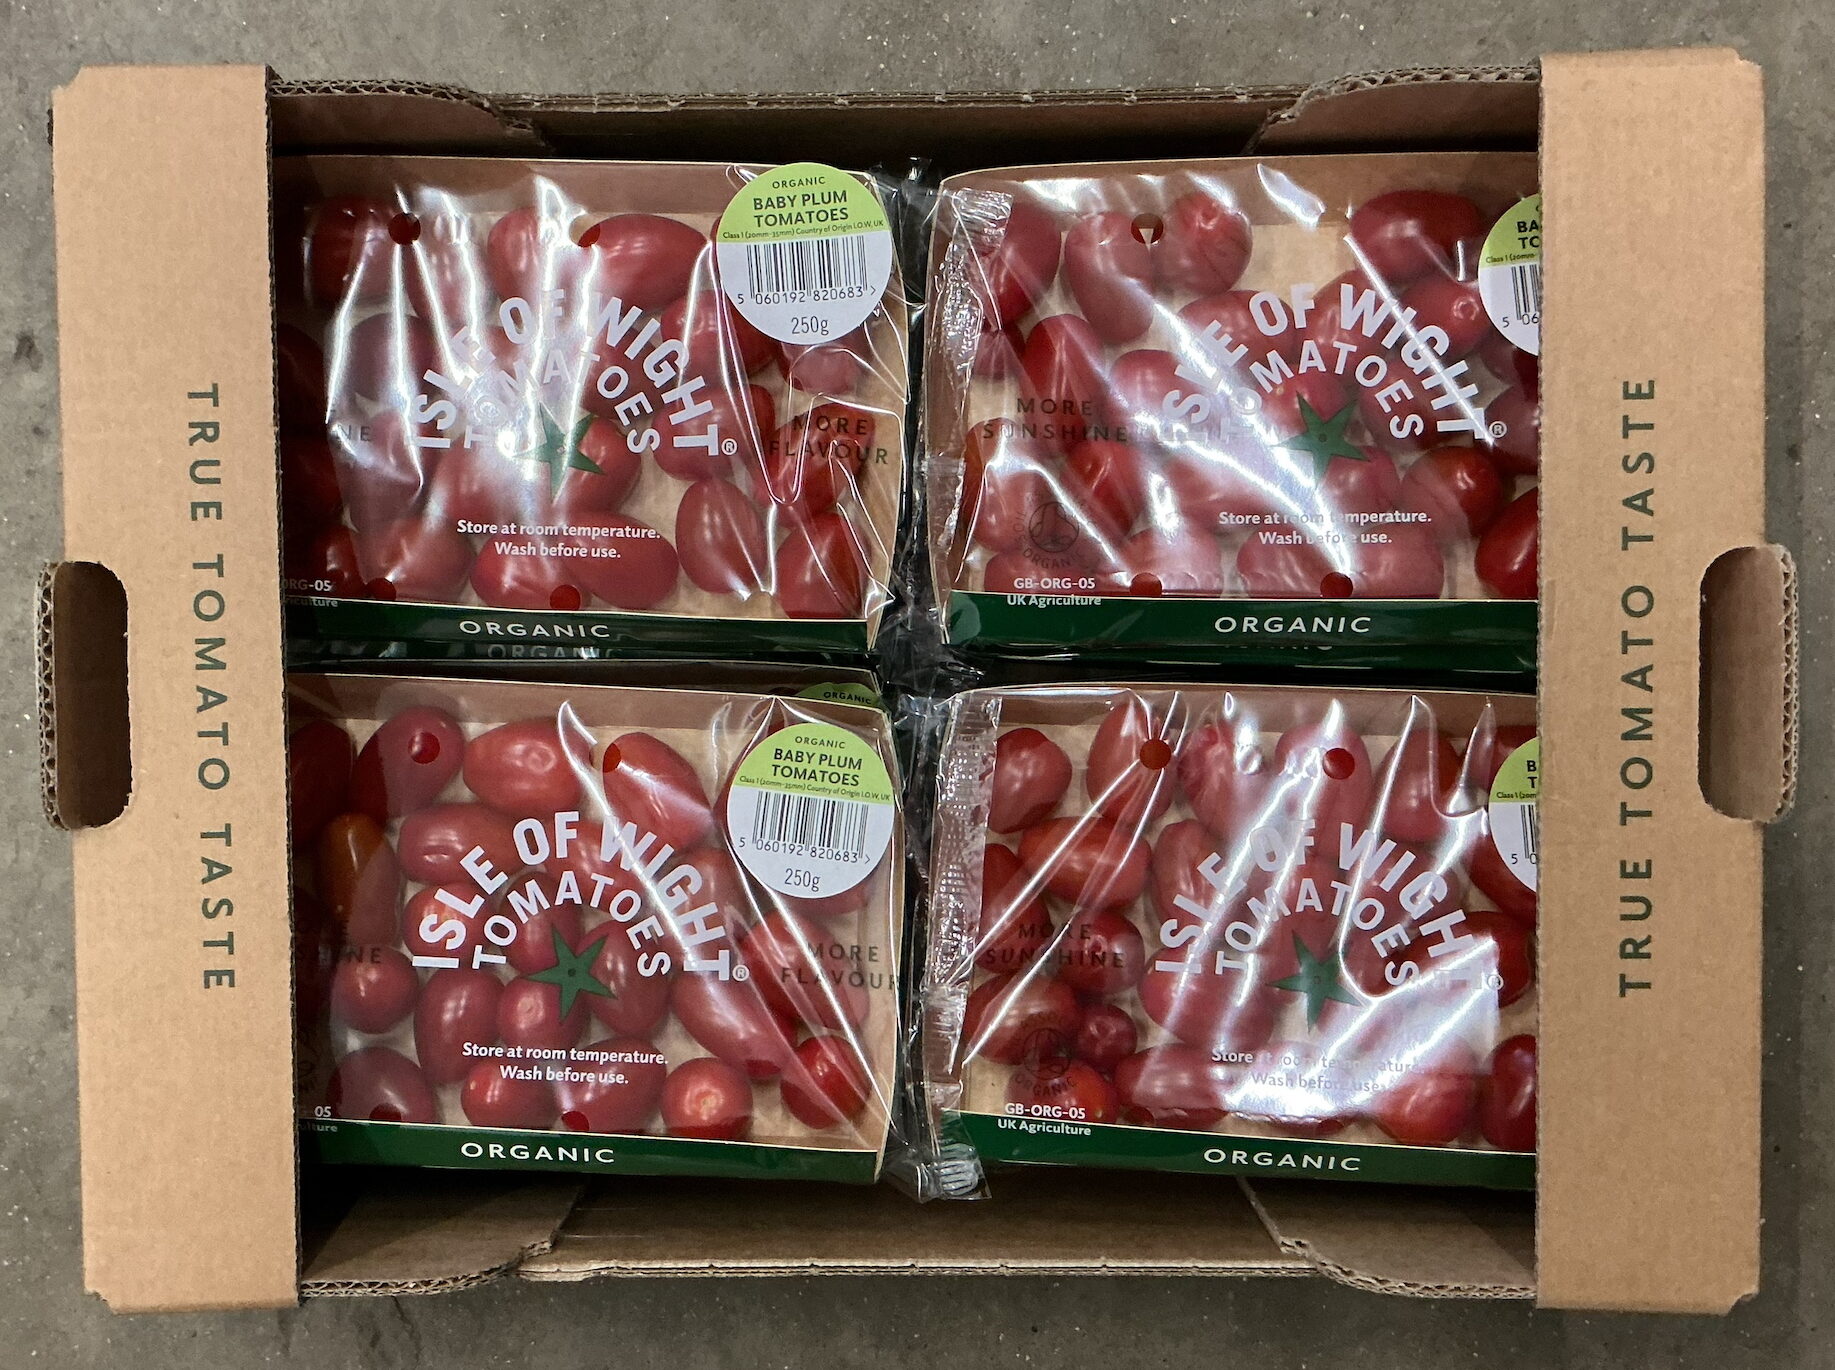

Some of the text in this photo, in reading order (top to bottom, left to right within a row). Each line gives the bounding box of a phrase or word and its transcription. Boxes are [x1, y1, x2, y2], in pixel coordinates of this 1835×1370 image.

[772, 177, 826, 189] ORGANIC
[753, 190, 848, 211] BABY PLUM
[754, 207, 849, 228] TOMATOES
[722, 231, 740, 239] Class
[796, 226, 823, 236] Country
[832, 224, 853, 233] Origin
[873, 219, 884, 227] UK
[737, 286, 864, 305] 5 060192 820683
[499, 288, 565, 346] OF
[1249, 282, 1315, 337] OF
[791, 316, 829, 335] 250g
[1016, 398, 1092, 415] MORE
[793, 416, 868, 435] MORE
[982, 422, 1128, 441] SUNSHINE
[770, 440, 888, 464] FLAVOUR
[1219, 511, 1261, 525] Store
[1264, 512, 1280, 525] at
[457, 520, 661, 540] Store at room temperature.
[1258, 530, 1302, 545] Wash
[1361, 532, 1393, 545] use.
[494, 542, 621, 559] Wash before use.
[1013, 577, 1096, 590] GB-ORG-05
[1006, 594, 1102, 608] UK Agriculture
[459, 620, 611, 638] ORGANIC
[1214, 617, 1371, 633] ORGANIC
[187, 382, 236, 990] TRUE TOMATO TASTE
[1619, 378, 1656, 998] TRUE TOMATO TASTE
[823, 691, 872, 705] ORGANIC
[794, 736, 846, 749] ORGANIC
[773, 748, 863, 771] BABY PLUM
[771, 764, 860, 787] TOMATOES
[739, 775, 755, 784] Class
[807, 784, 833, 795] Country
[833, 787, 840, 795] of
[840, 789, 861, 799] Origin
[880, 793, 891, 802] UK
[738, 836, 859, 863] 5 060192 820683
[411, 845, 508, 969] ISLE
[512, 811, 580, 865] OF
[784, 868, 821, 892] 250g
[1155, 852, 1247, 974] ISLE
[1250, 819, 1316, 872] OF
[472, 870, 672, 977] TOMATOES
[1215, 878, 1420, 986] TOMATOES
[808, 942, 880, 962] MORE
[984, 947, 1124, 969] SUNHINE
[462, 1041, 669, 1065] Store at room temperature.
[1211, 1050, 1253, 1063] Store
[499, 1065, 629, 1084] Wash before use.
[1251, 1071, 1294, 1087] Wash
[1004, 1102, 1087, 1119] GB-ORG-05
[997, 1118, 1092, 1136] UK Agriculture
[460, 1142, 615, 1163] ORGANIC
[1203, 1148, 1361, 1171] ORGANIC
